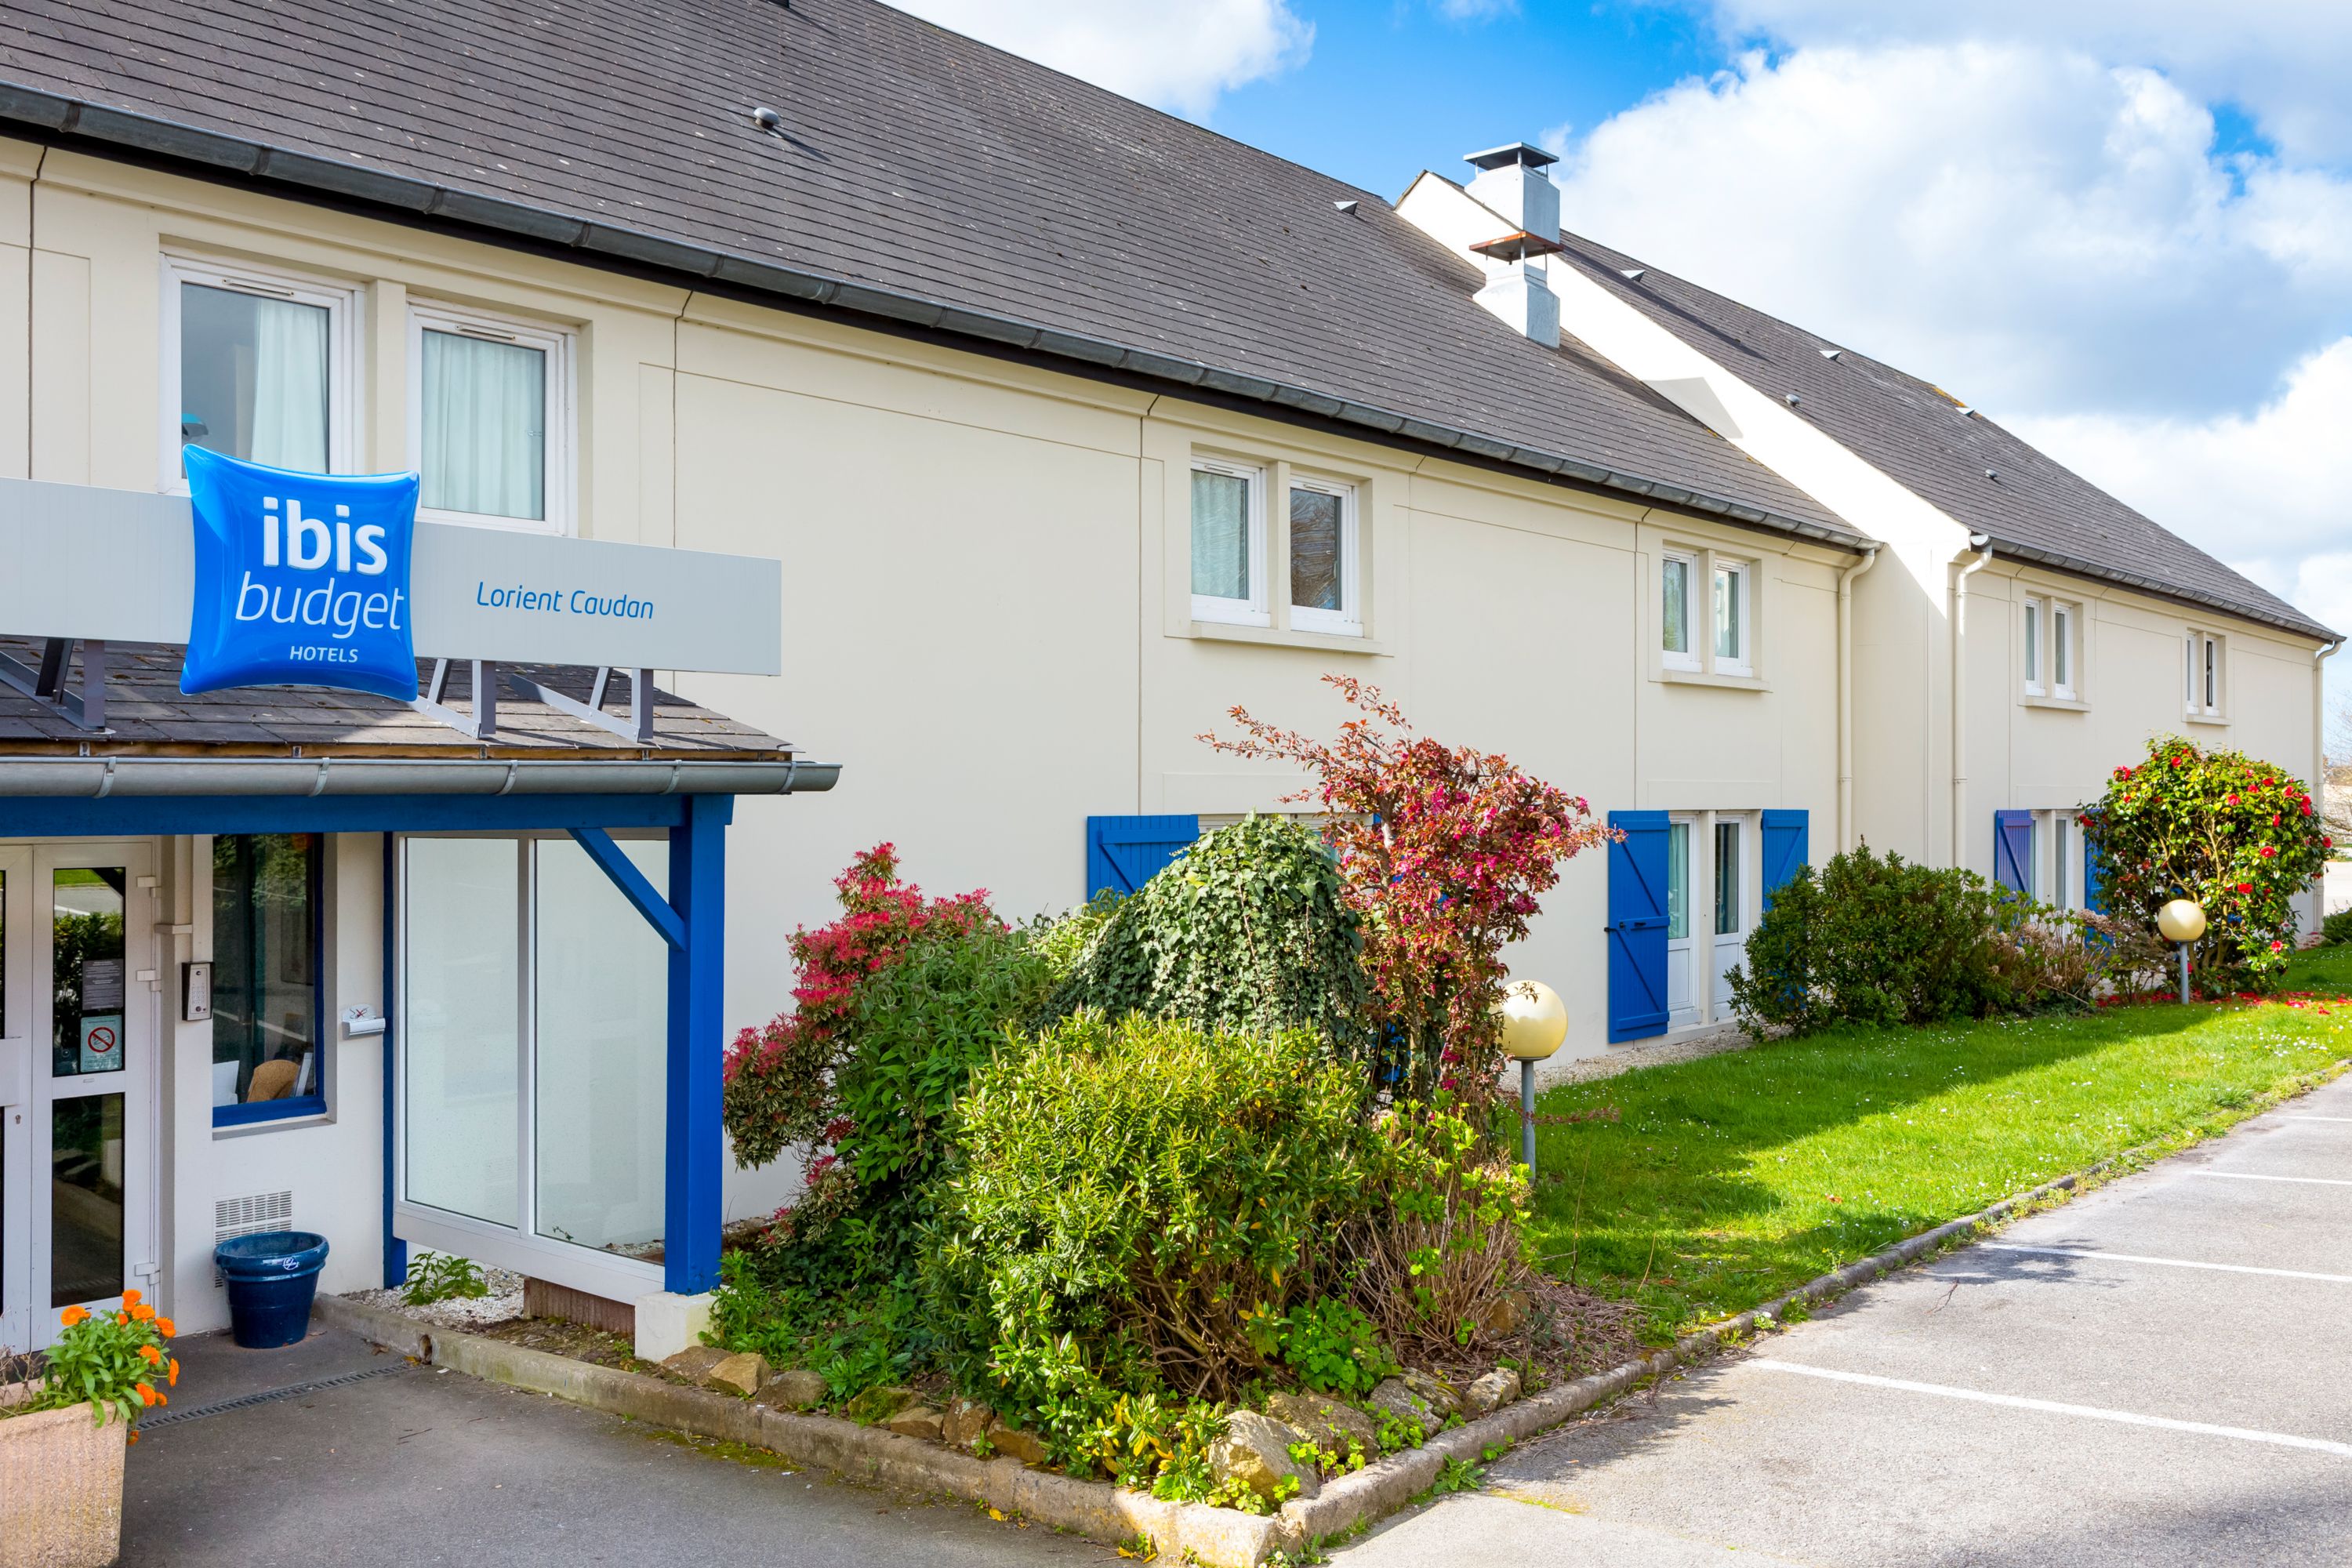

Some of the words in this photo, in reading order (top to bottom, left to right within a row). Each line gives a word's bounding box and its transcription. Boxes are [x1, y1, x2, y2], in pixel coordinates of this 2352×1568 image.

[263, 496, 387, 575] ibis
[235, 571, 405, 639] budget
[477, 581, 563, 612] Lorient
[570, 590, 654, 619] Caudan
[289, 645, 358, 663] HOTELS
